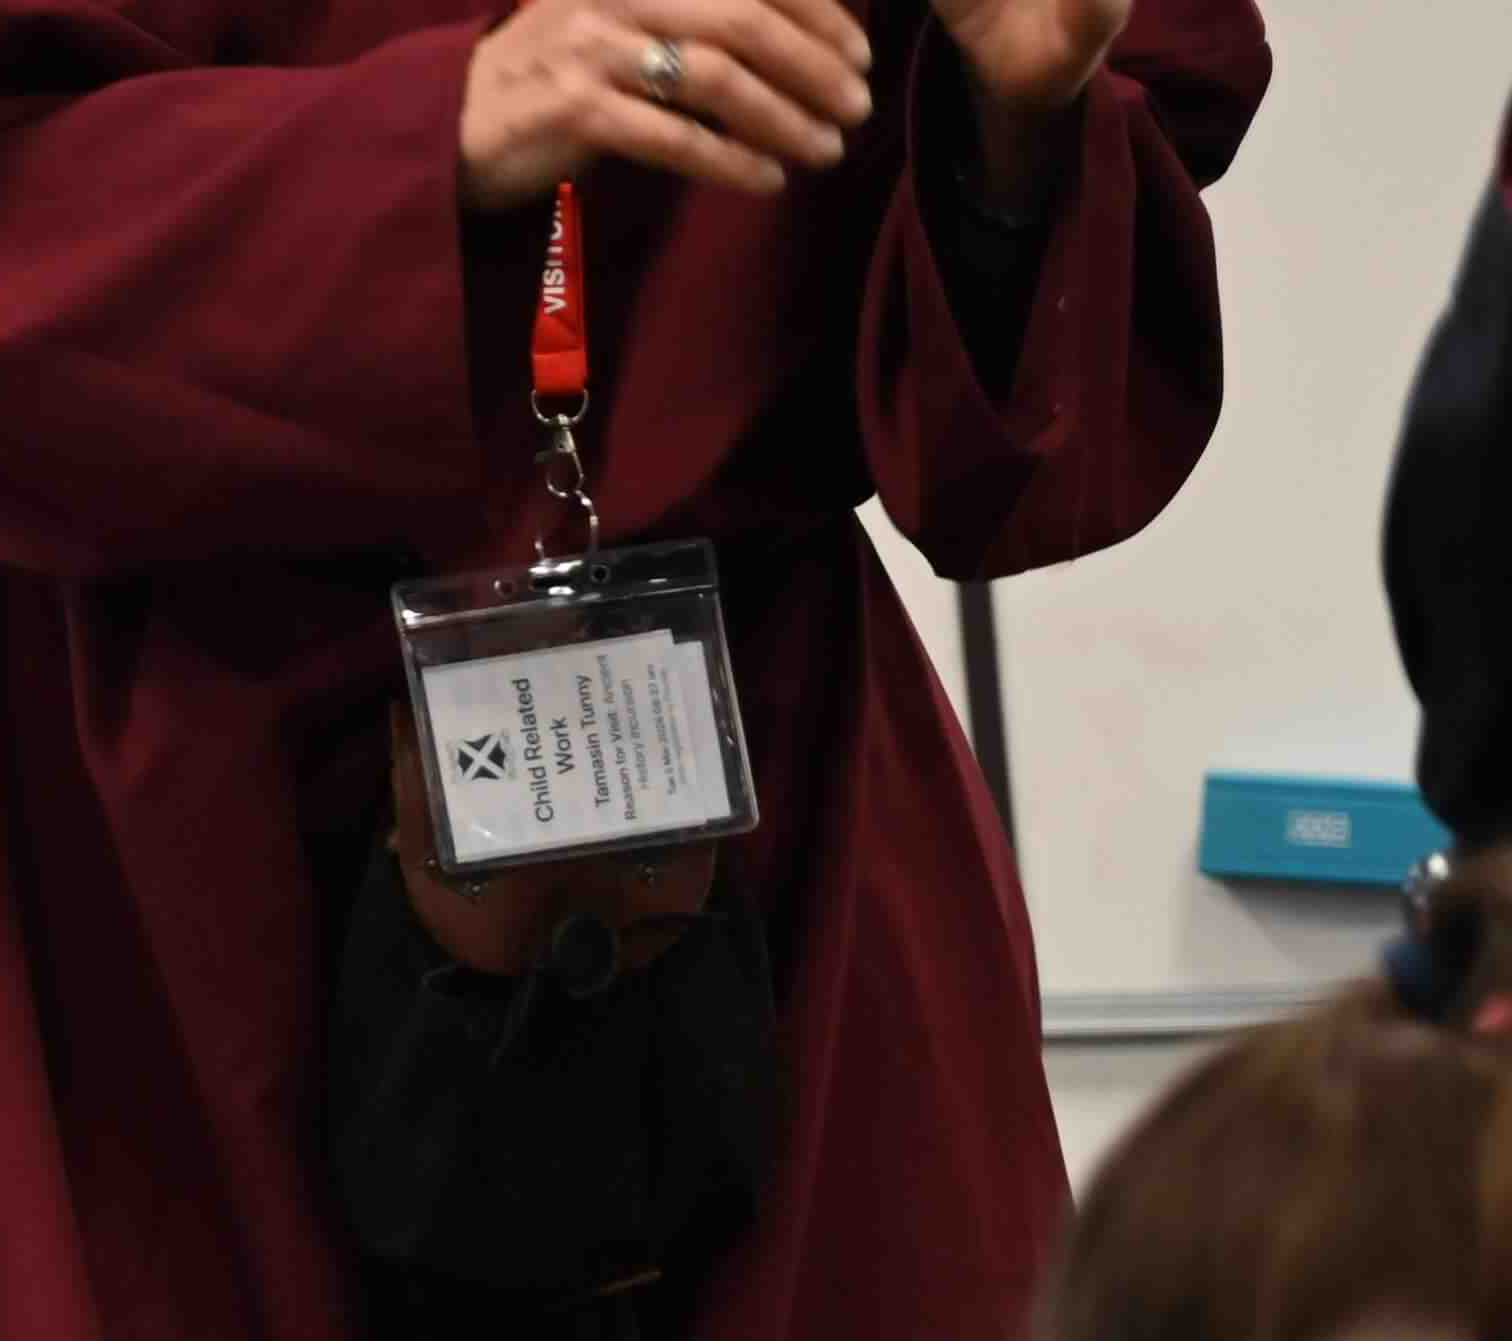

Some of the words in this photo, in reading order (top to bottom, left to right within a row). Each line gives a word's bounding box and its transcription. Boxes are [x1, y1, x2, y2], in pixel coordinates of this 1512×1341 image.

[514, 678, 542, 763] Related
[551, 717, 575, 775] Work
[531, 766, 554, 822] Child
